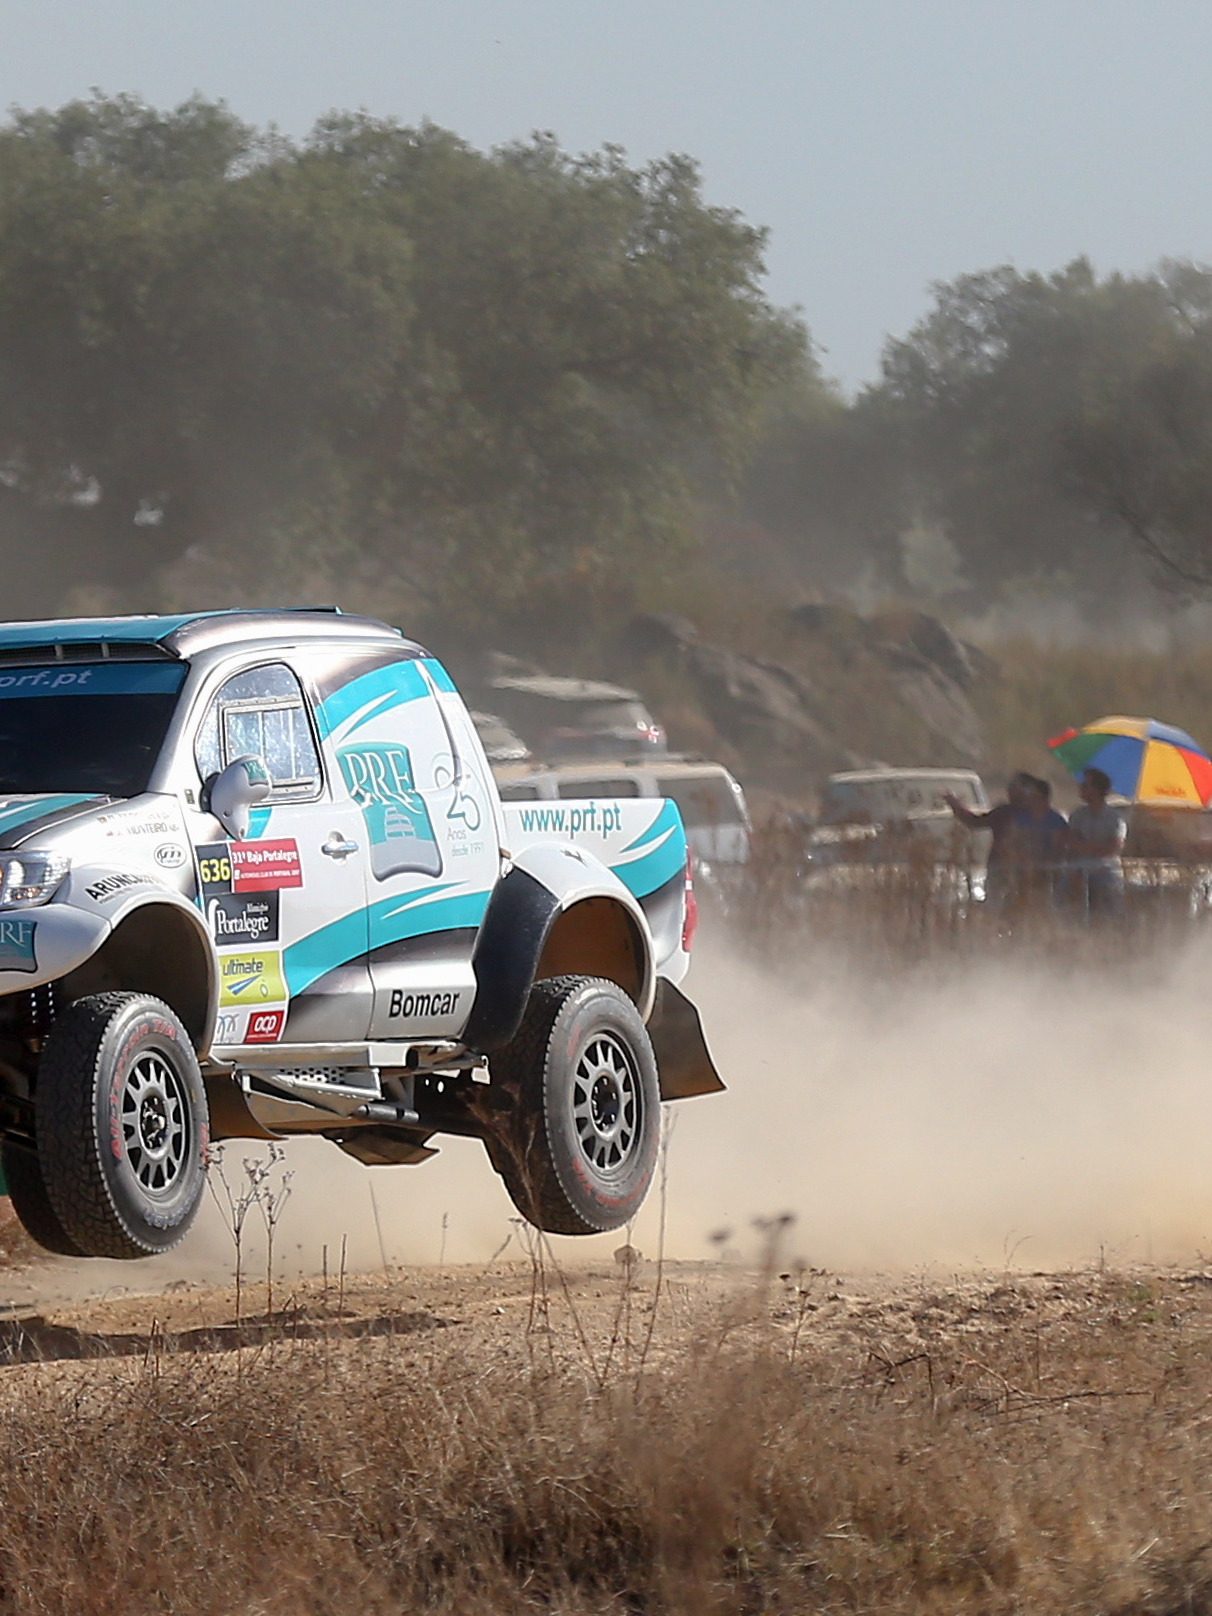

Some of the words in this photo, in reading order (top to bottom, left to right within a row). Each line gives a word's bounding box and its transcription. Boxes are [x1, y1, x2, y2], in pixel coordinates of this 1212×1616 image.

[344, 750, 423, 814] PRF
[519, 802, 623, 839] www.prf.pt
[200, 858, 231, 882] 636
[247, 850, 263, 865] Baja
[263, 849, 298, 863] Portalegre
[216, 909, 269, 939] Portalegre
[222, 957, 264, 976] ultimate
[388, 989, 461, 1018] Bomcar
